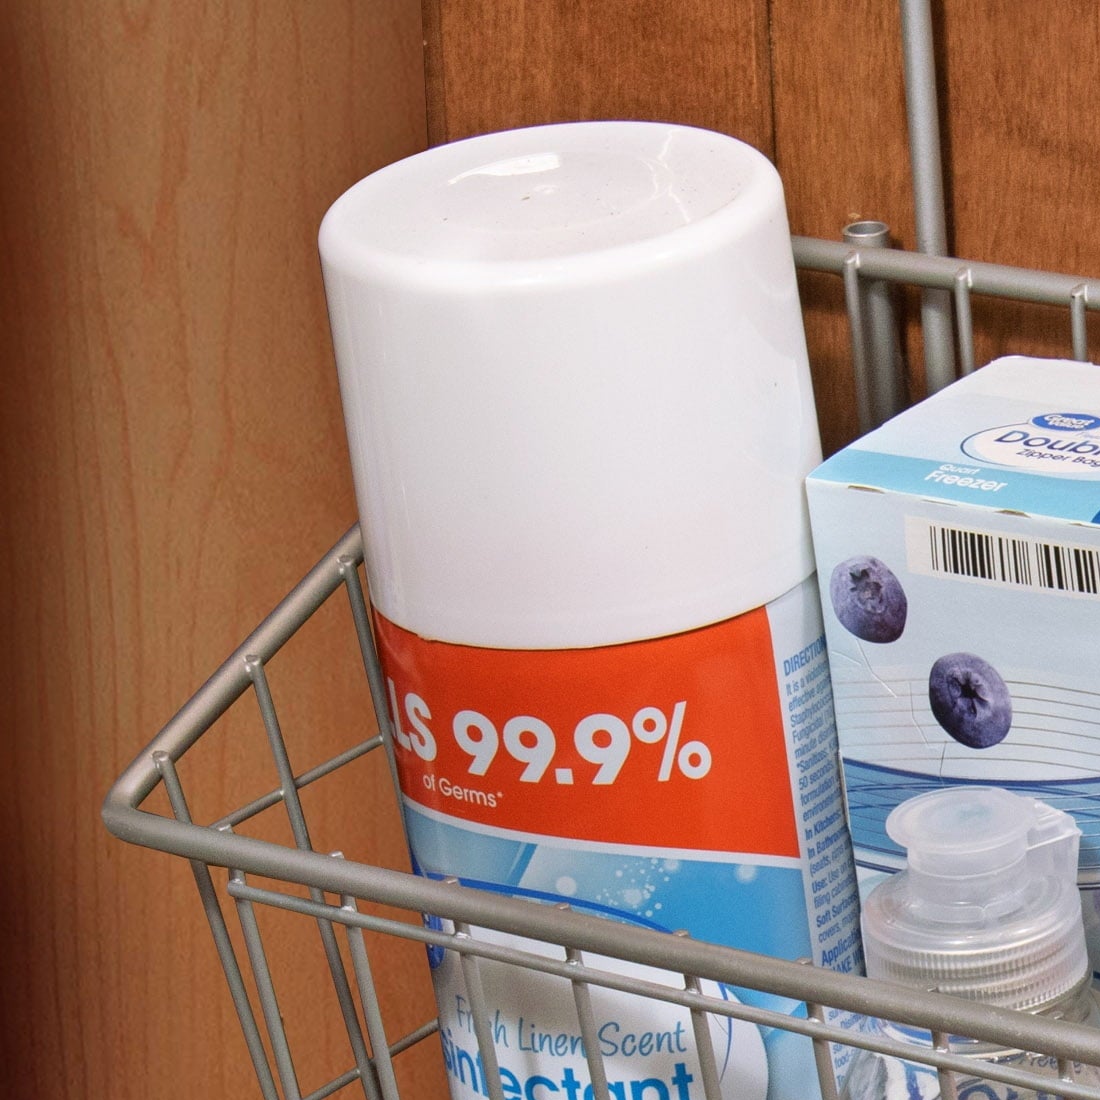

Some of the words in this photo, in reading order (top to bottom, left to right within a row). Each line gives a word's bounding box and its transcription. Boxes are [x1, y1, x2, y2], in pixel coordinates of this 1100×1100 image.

[1016, 448, 1069, 463] Zipper
[938, 463, 981, 476] Quart
[924, 470, 1008, 492] Freezer
[388, 676, 438, 762] LS
[453, 701, 712, 785] 99.9%
[422, 774, 437, 792] of
[456, 994, 509, 1048] Frh
[598, 1021, 688, 1058] Scent
